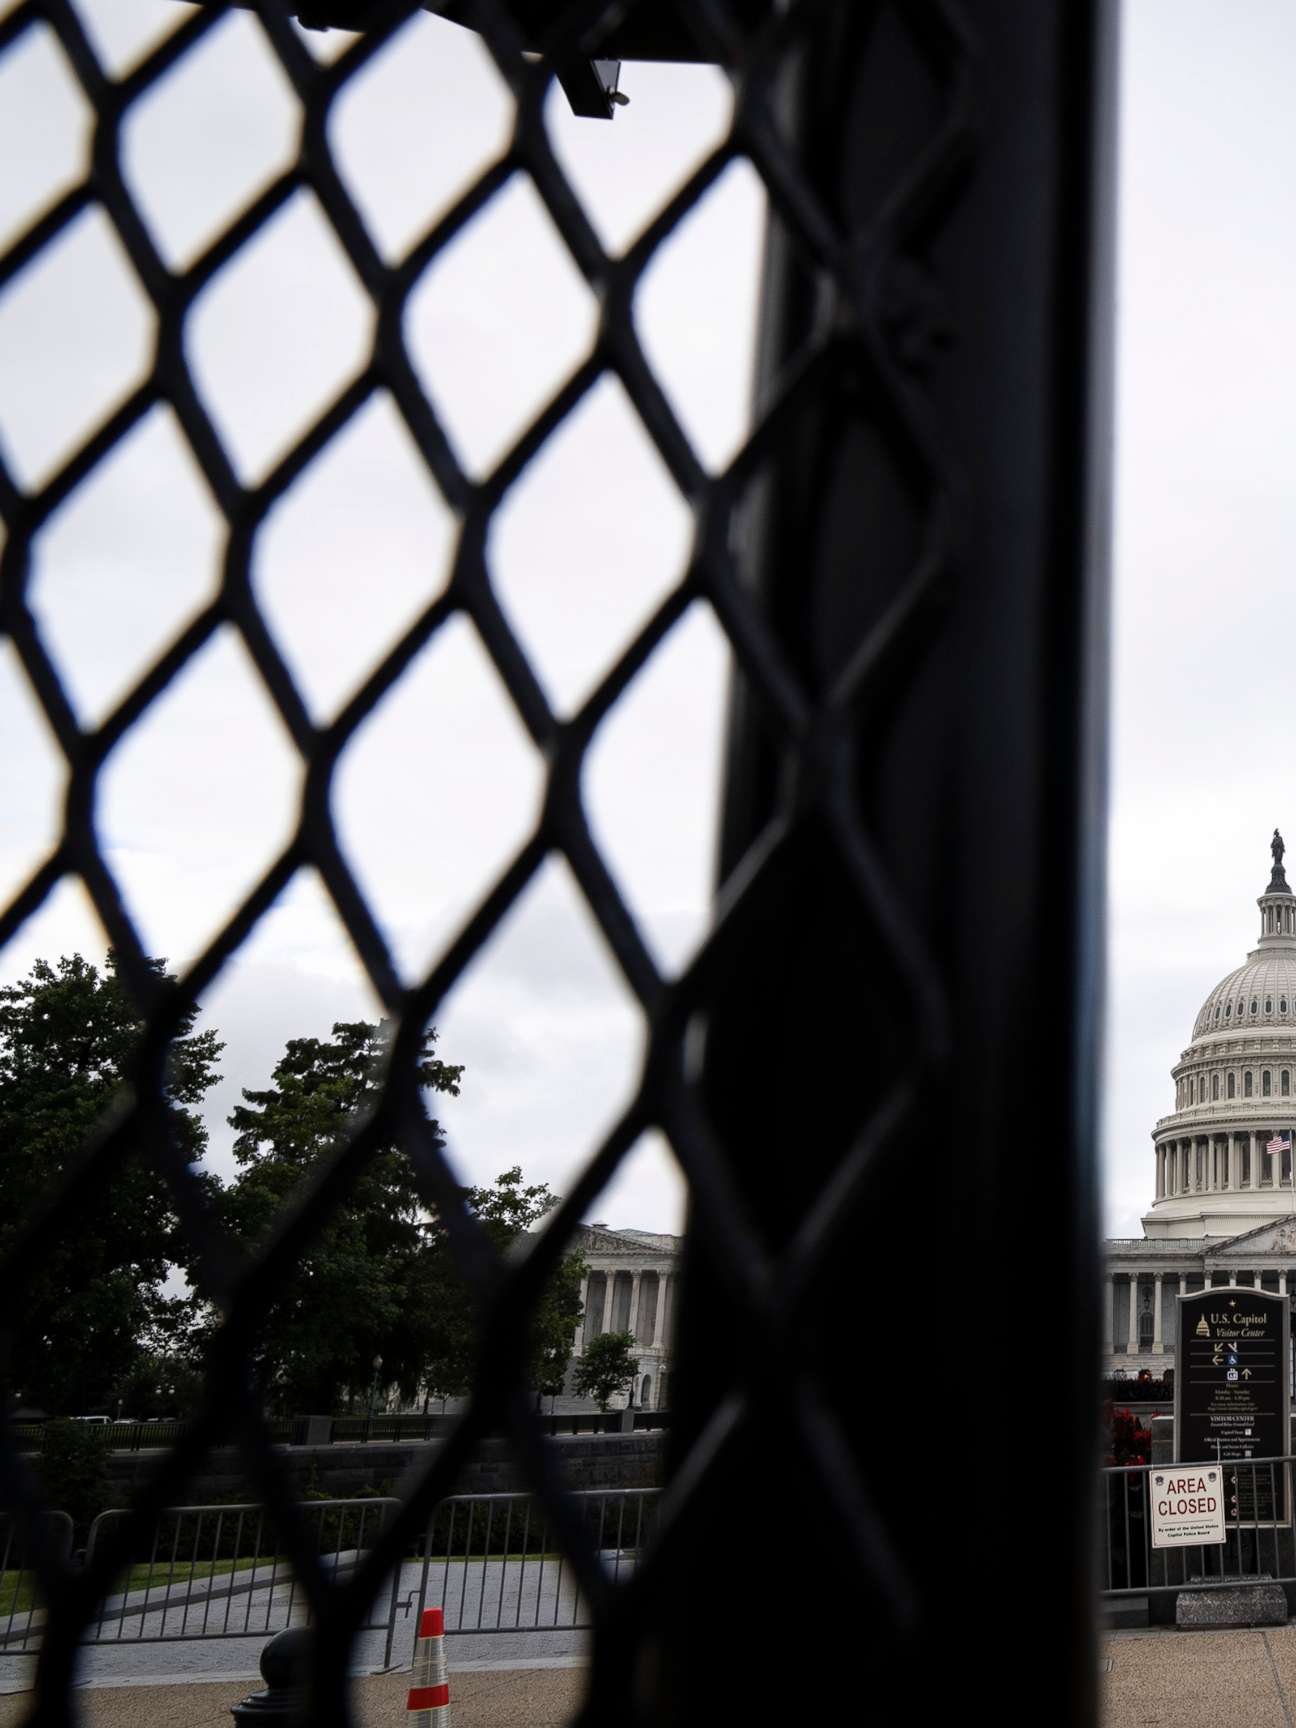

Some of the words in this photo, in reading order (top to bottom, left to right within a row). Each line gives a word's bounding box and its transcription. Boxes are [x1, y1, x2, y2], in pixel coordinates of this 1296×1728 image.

[1210, 1313, 1231, 1324] U.S.
[1232, 1312, 1267, 1327] Capitol
[1216, 1328, 1240, 1337] Visitor
[1240, 1328, 1266, 1337] Center
[1167, 1477, 1207, 1495] AREA
[1158, 1497, 1217, 1516] CLOSED
